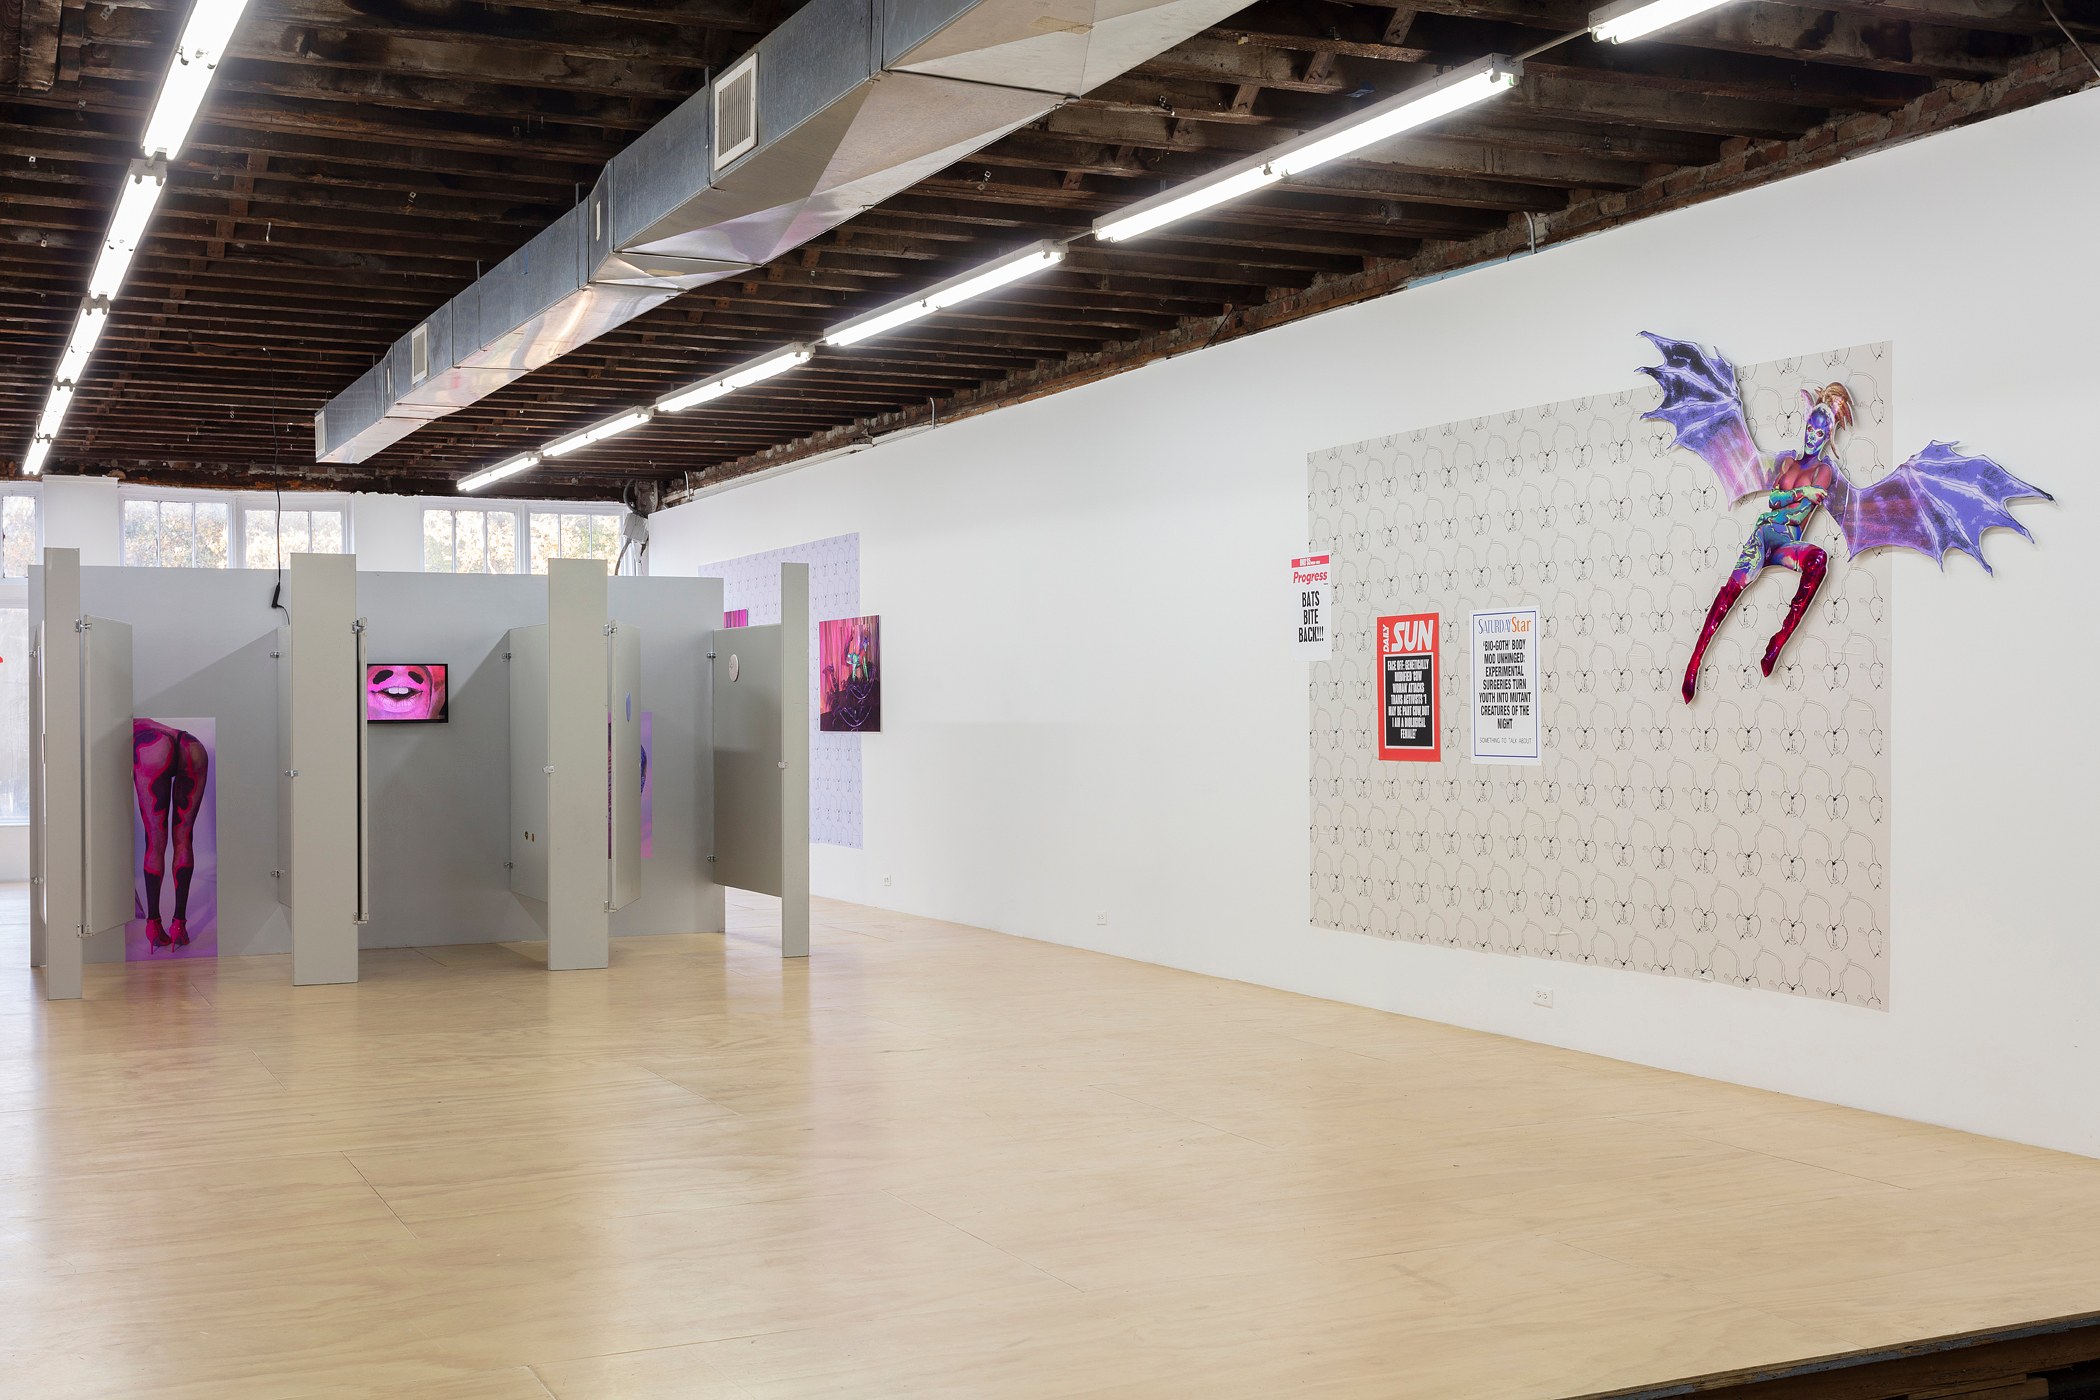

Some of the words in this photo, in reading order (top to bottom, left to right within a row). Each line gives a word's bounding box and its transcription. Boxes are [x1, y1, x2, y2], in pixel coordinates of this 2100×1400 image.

[1293, 571, 1328, 585] Progress
[1302, 591, 1320, 607] BATS
[1303, 609, 1319, 625] BITE
[1511, 616, 1531, 633] Star
[1298, 626, 1324, 642] BACK!!!
[1391, 619, 1434, 652] SUN
[1511, 639, 1526, 650] BODY
[1484, 653, 1496, 664] MOD
[1485, 665, 1524, 677] EXPERIMENTAL
[1482, 679, 1511, 690] SURGERIES
[1512, 678, 1526, 690] TURN
[1479, 692, 1496, 703] YOUTH
[1496, 692, 1509, 703] INTO
[1510, 692, 1531, 702] MUTANT
[1480, 705, 1510, 716] CREATURES
[1511, 705, 1519, 715] OF
[1519, 705, 1530, 716] THE
[1497, 718, 1513, 729] NIGHT
